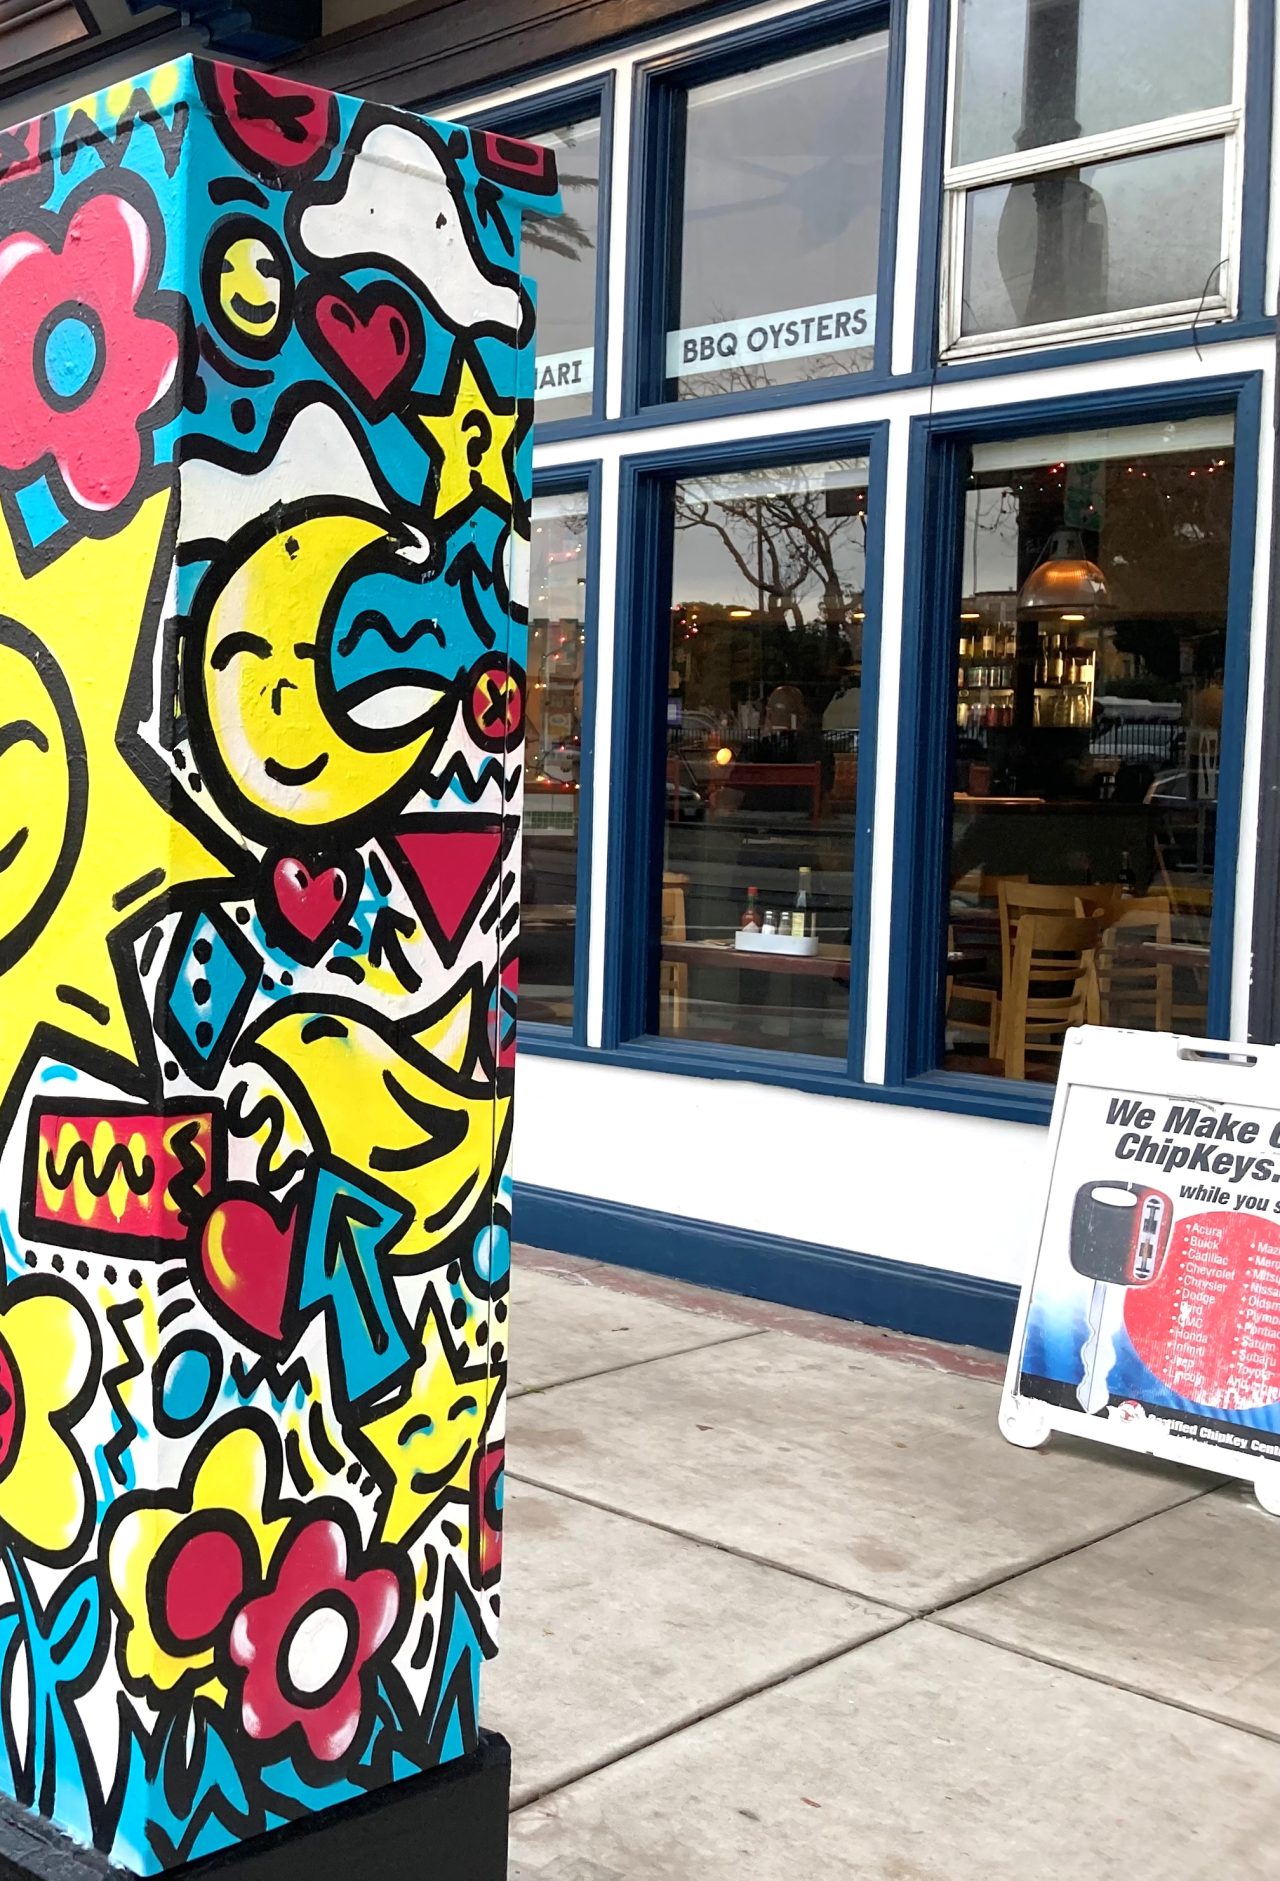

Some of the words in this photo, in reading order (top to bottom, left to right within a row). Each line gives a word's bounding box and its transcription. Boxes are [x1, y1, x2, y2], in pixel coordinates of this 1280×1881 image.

[683, 332, 738, 363] BBQ
[747, 308, 868, 352] OYSTERS
[535, 360, 582, 390] ARI
[1106, 1098, 1156, 1129] We
[1162, 1106, 1260, 1144] Make
[1179, 1184, 1230, 1205] while
[1233, 1194, 1270, 1213] you
[1191, 1223, 1223, 1237] Acura
[1190, 1236, 1219, 1249] Buick
[1257, 1241, 1280, 1255] Maz
[1188, 1248, 1229, 1265] Cadillac
[1185, 1262, 1235, 1280] Chevrolet
[1253, 1269, 1280, 1284] Mitsu
[1184, 1275, 1227, 1292] Chrysler
[1250, 1283, 1280, 1297] Nissa
[1182, 1288, 1216, 1305] Dodge
[1248, 1296, 1280, 1311] Oldsm
[1246, 1309, 1280, 1324] Plymo
[1175, 1329, 1208, 1343] Honda
[1242, 1336, 1276, 1351] Saturn
[1239, 1349, 1276, 1366] Subaru
[1200, 1427, 1248, 1449] ChipKey
[1251, 1440, 1280, 1456] Cent
